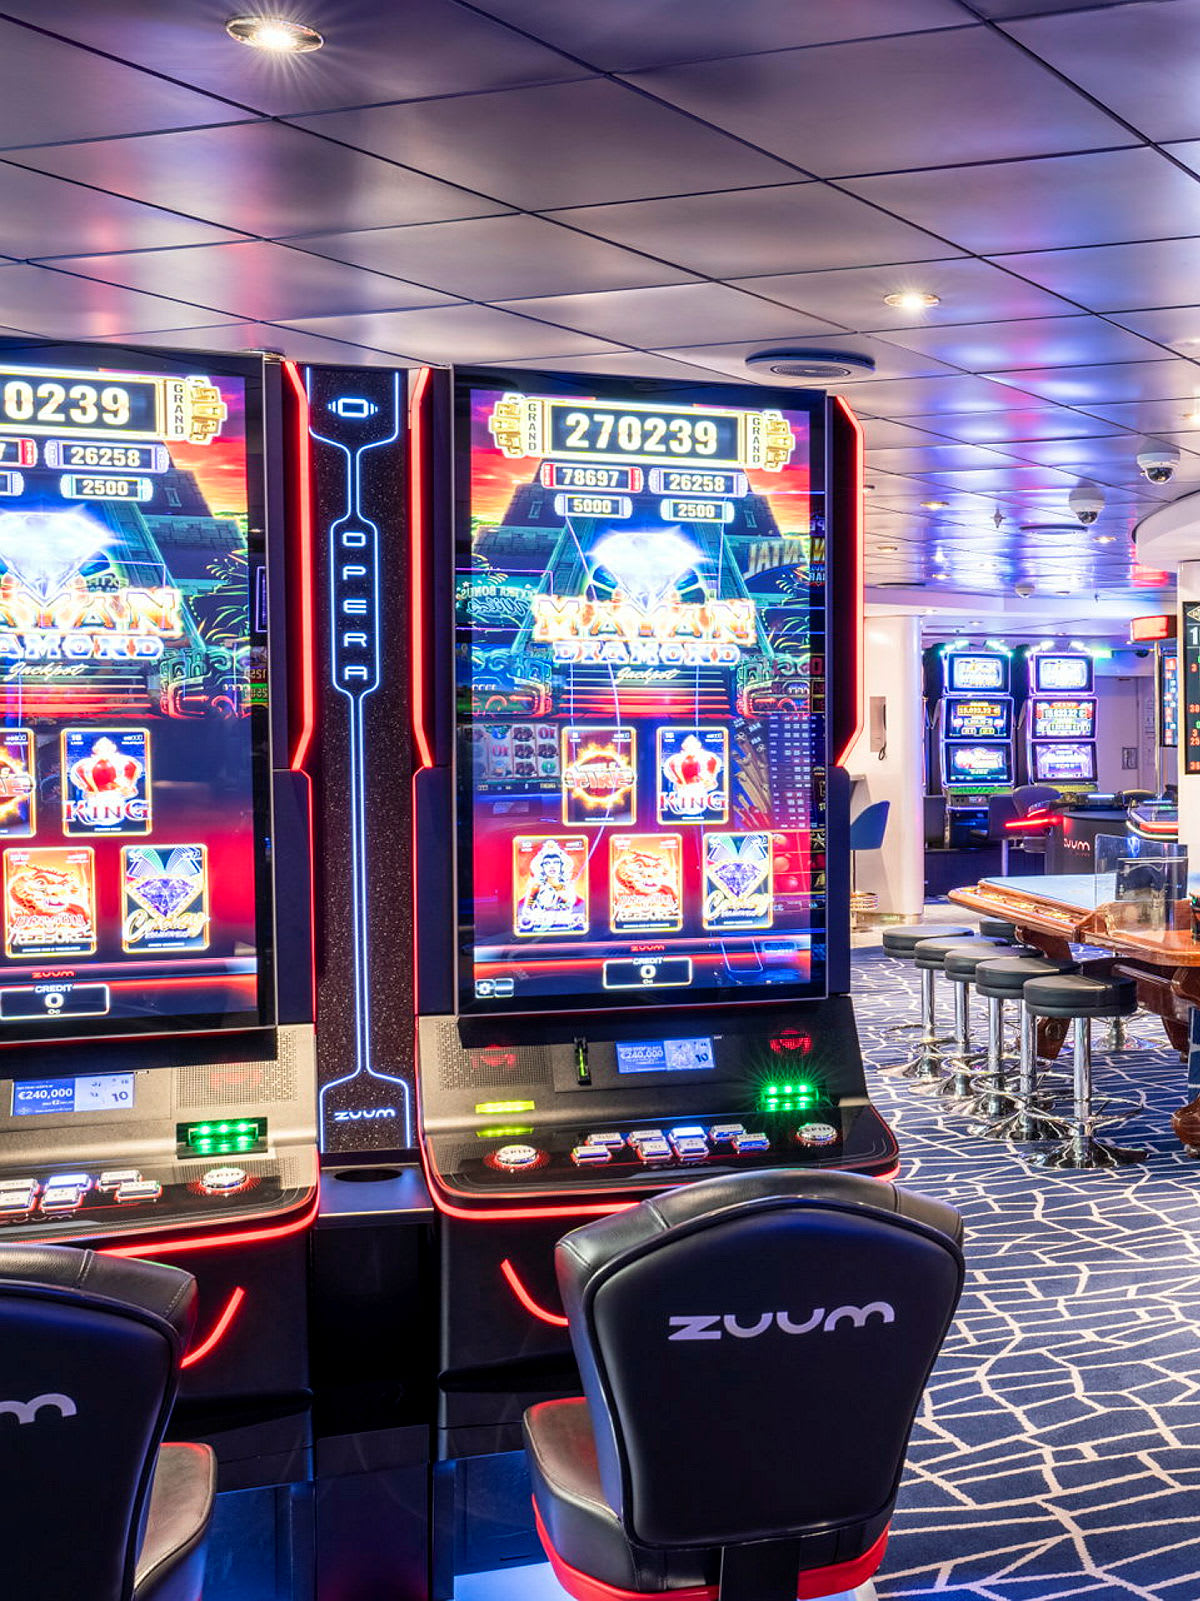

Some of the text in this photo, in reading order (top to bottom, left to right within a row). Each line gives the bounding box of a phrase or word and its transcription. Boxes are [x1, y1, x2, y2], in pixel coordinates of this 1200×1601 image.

[173, 383, 185, 435] GRAND
[527, 403, 537, 451] GRAND
[565, 413, 719, 454] 270239
[751, 416, 761, 463] GRAND
[70, 446, 141, 467] 26258
[82, 479, 129, 495] 2500
[562, 468, 619, 487] 78697
[669, 473, 726, 493] 26258
[573, 498, 612, 513] 5000
[678, 504, 715, 518] 2500
[342, 532, 368, 680] OPERA
[535, 597, 757, 643] MAYAN
[553, 641, 740, 665] DIAMOND
[3, 662, 89, 681] Jackpot
[660, 791, 728, 811] KING
[63, 801, 151, 822] KING
[633, 957, 664, 965] CREDIT
[640, 965, 657, 979] 0
[35, 984, 73, 993] CREDIT
[44, 993, 64, 1009] 0
[620, 1049, 664, 1060] €240,000
[695, 1052, 709, 1062] 10
[18, 1088, 73, 1100] €240,000
[112, 1091, 128, 1102] 10
